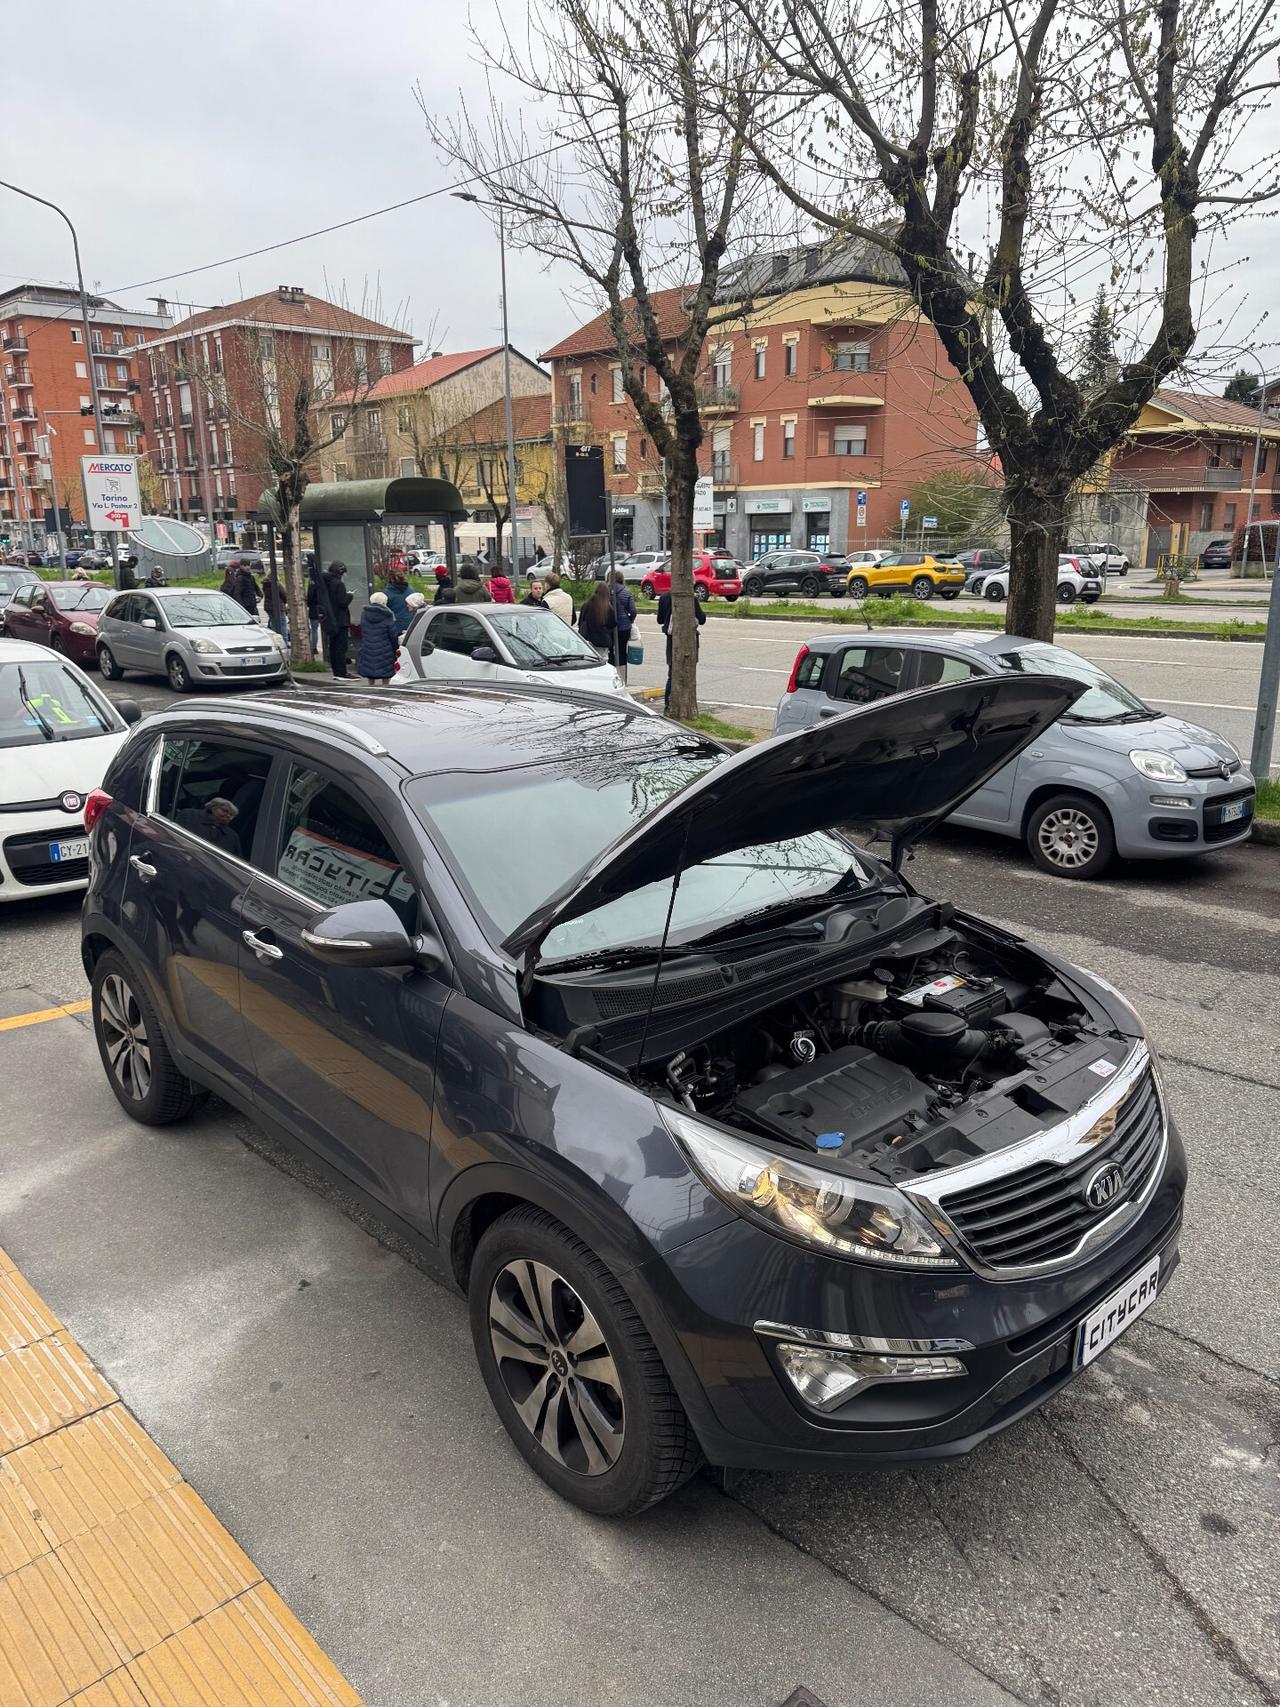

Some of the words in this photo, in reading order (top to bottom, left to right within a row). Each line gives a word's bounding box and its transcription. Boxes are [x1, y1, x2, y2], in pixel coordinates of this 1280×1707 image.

[88, 463, 132, 472] MERCATO
[1093, 1169, 1123, 1205] KIA
[1089, 1270, 1158, 1351] CITYCAR
[552, 1353, 565, 1375] KIA
